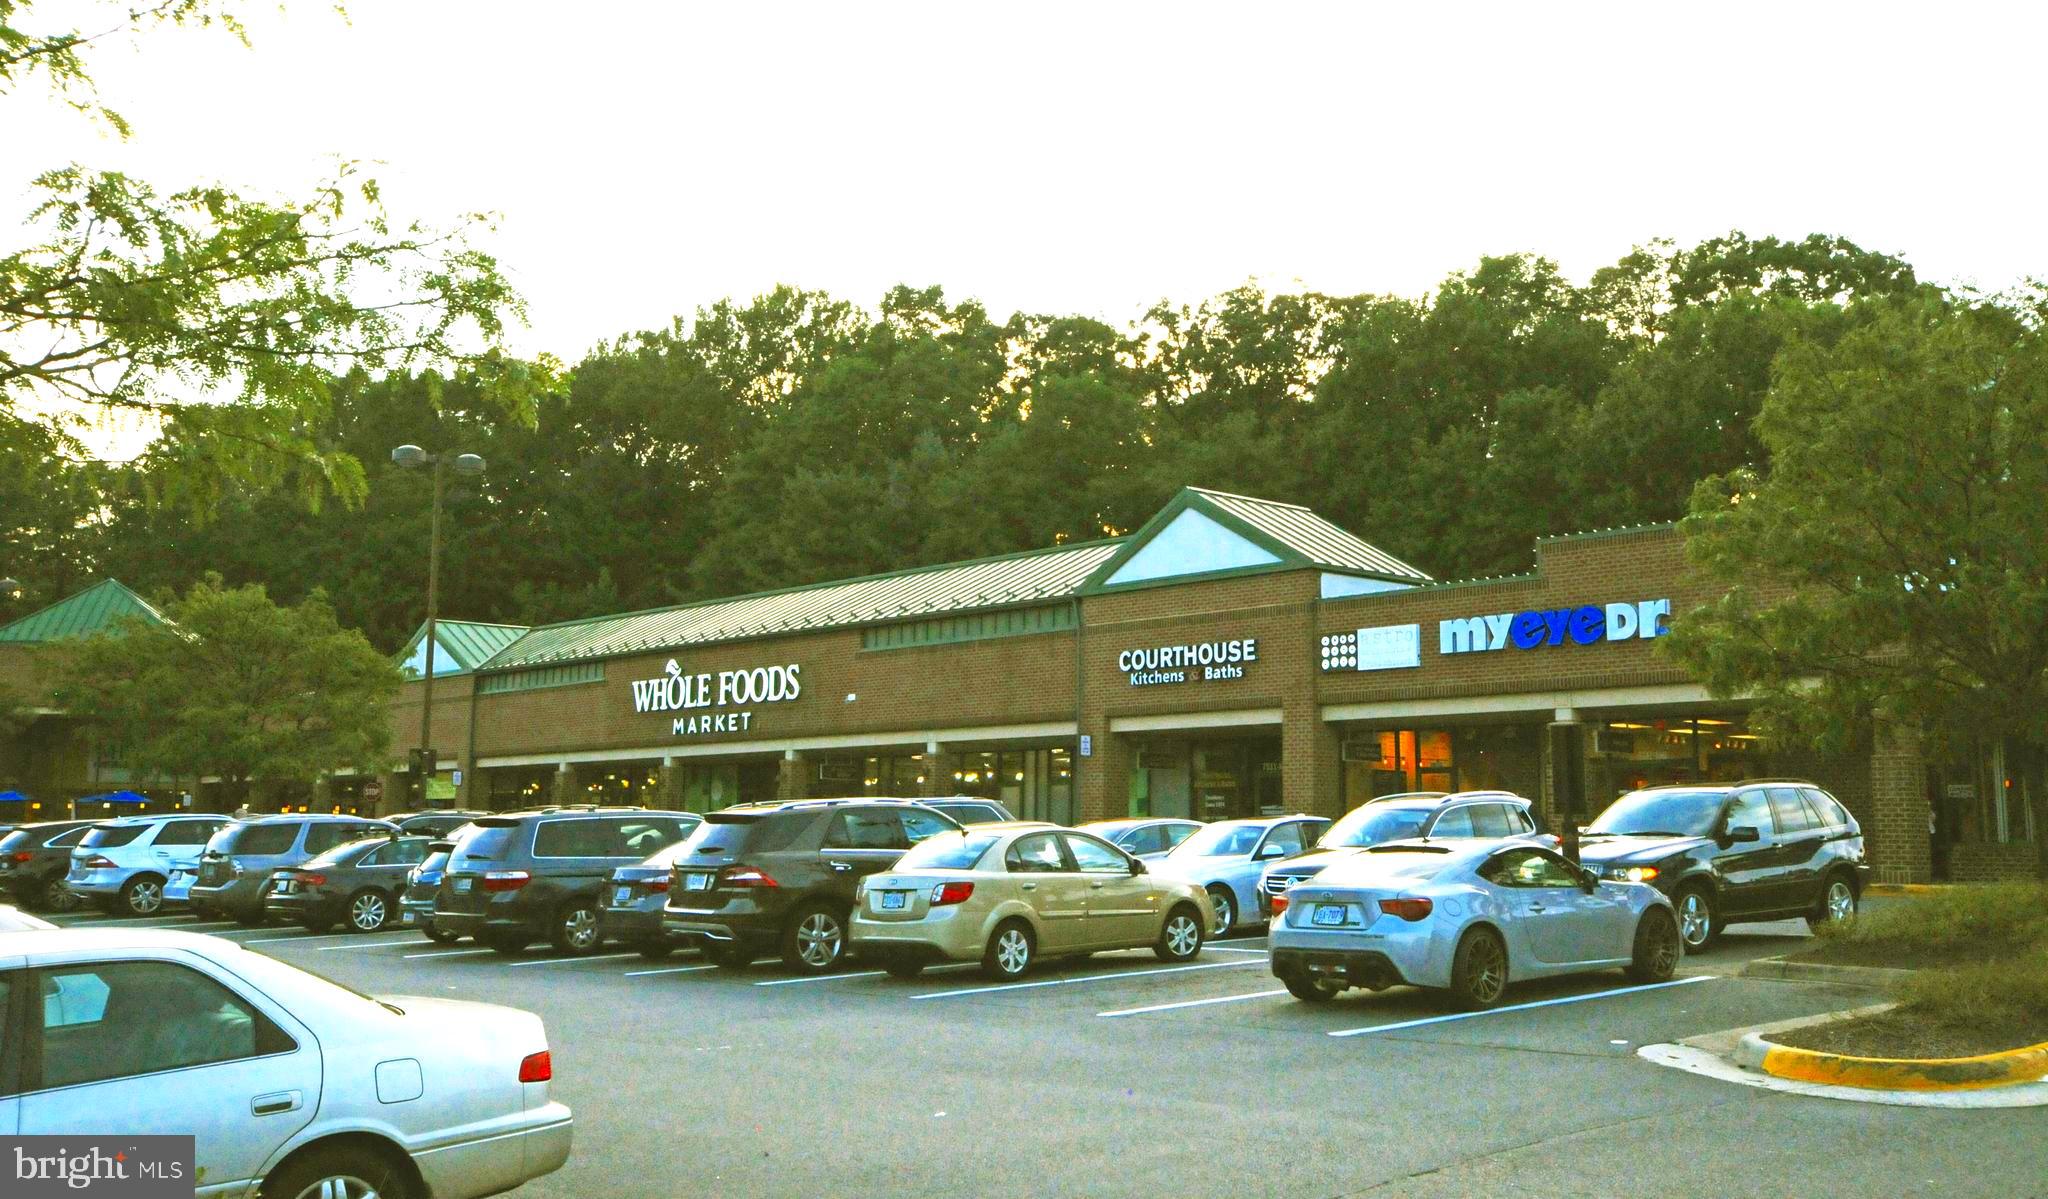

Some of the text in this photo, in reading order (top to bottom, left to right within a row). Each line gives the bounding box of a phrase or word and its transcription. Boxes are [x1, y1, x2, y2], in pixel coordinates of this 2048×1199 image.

[1119, 639, 1256, 671] COURTHOUSE
[1130, 671, 1185, 685] Kitchens
[1205, 664, 1243, 680] Baths
[632, 661, 801, 712] WHOLE FOODS
[673, 712, 751, 735] MARKET
[365, 788, 379, 796] STOP
